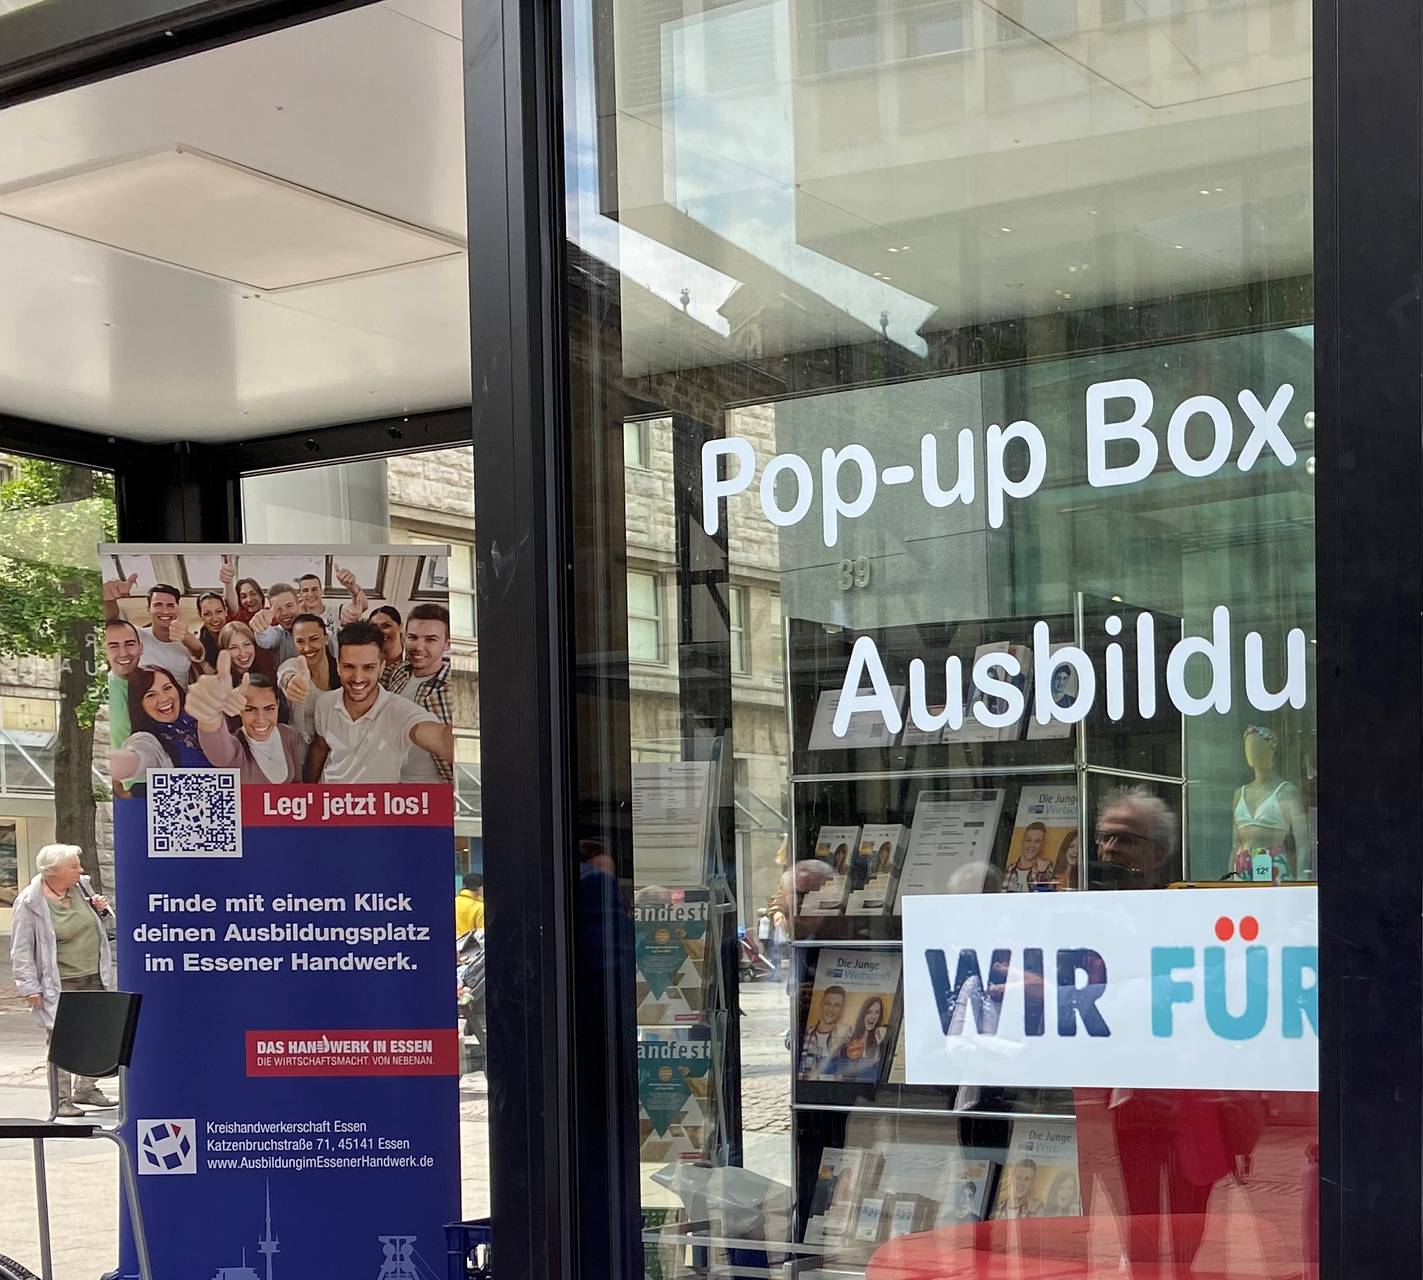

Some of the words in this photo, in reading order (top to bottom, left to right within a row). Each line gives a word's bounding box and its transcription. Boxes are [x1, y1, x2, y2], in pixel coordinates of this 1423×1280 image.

[701, 420, 1046, 548] Pop-up
[838, 556, 871, 591] 39
[263, 792, 315, 819] Leg'
[322, 792, 376, 818] jetzt
[383, 791, 429, 816] los!
[1039, 793, 1054, 803] Die
[148, 893, 216, 912] Finde
[225, 893, 264, 912] mit
[271, 893, 346, 912] einem
[354, 892, 412, 912] Klick
[133, 923, 216, 942] deinen
[224, 923, 430, 944] Ausbildungsplatz
[145, 954, 174, 972] im
[183, 953, 284, 972] Essener
[291, 952, 418, 972] Handwerk.
[837, 957, 852, 969] Die
[855, 959, 880, 972] Junge
[924, 947, 1111, 1037] WIR
[1151, 916, 1319, 1041] FÜR
[257, 1041, 284, 1054] DAS
[373, 1041, 386, 1053] IN
[390, 1040, 432, 1053] ESSEN
[257, 1057, 271, 1067] DIE
[274, 1056, 368, 1066] WIRTSCHAFTSMACHT.
[373, 1056, 390, 1065] VON
[392, 1055, 435, 1065] NEBENAN.
[206, 1120, 331, 1134] Kreishandwerkerschaft
[334, 1120, 367, 1133] Essen
[206, 1138, 313, 1152] Katzenbruchstraße
[317, 1138, 335, 1151] 71,
[338, 1138, 374, 1150] 45141
[378, 1138, 410, 1150] Essen
[1029, 1129, 1044, 1141] Die
[1044, 1131, 1072, 1145] Junge
[206, 1155, 434, 1171] www.AusbildungimEssenerHandwerk.de
